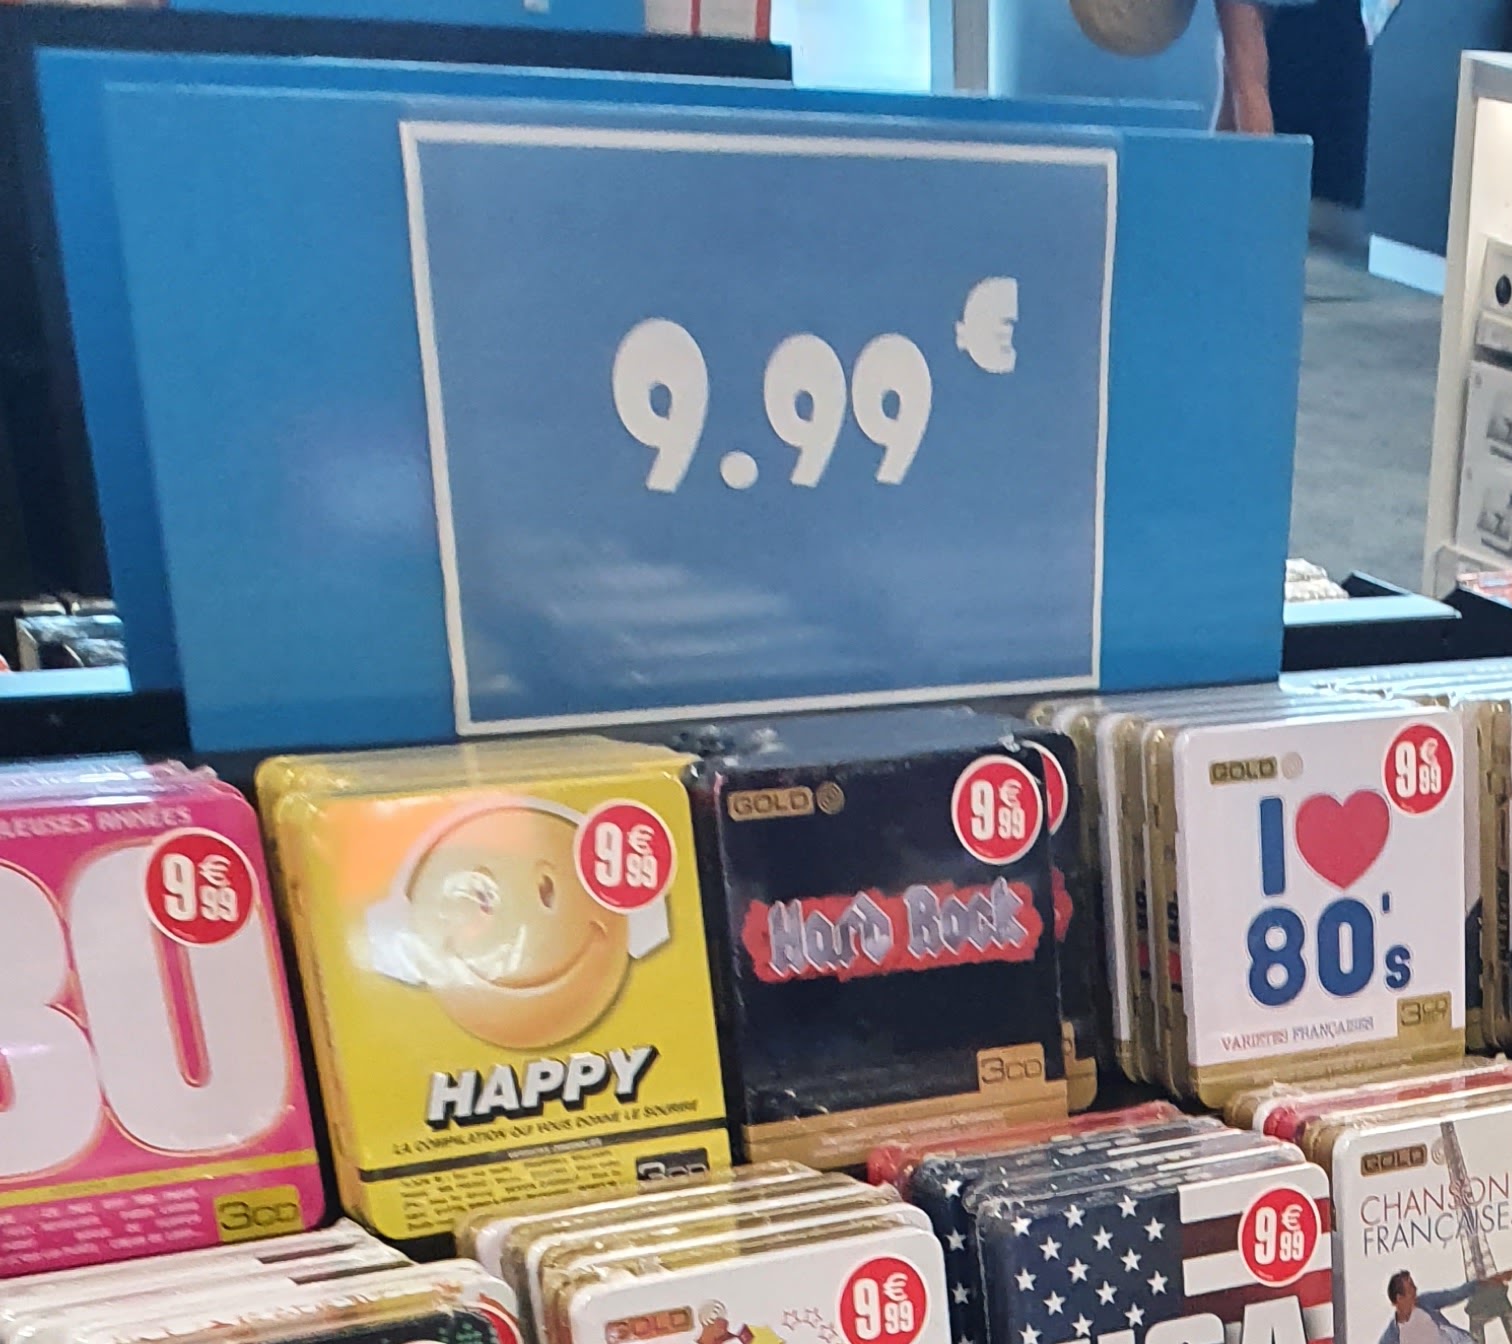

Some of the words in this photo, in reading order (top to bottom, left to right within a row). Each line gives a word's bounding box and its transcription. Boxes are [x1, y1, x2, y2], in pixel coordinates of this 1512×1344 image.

[1212, 761, 1276, 781] GOLD
[733, 790, 811, 816] GOLD
[426, 1045, 660, 1130] HAPPY
[1362, 1146, 1426, 1175] GOLD
[608, 1307, 693, 1344] GOLD
